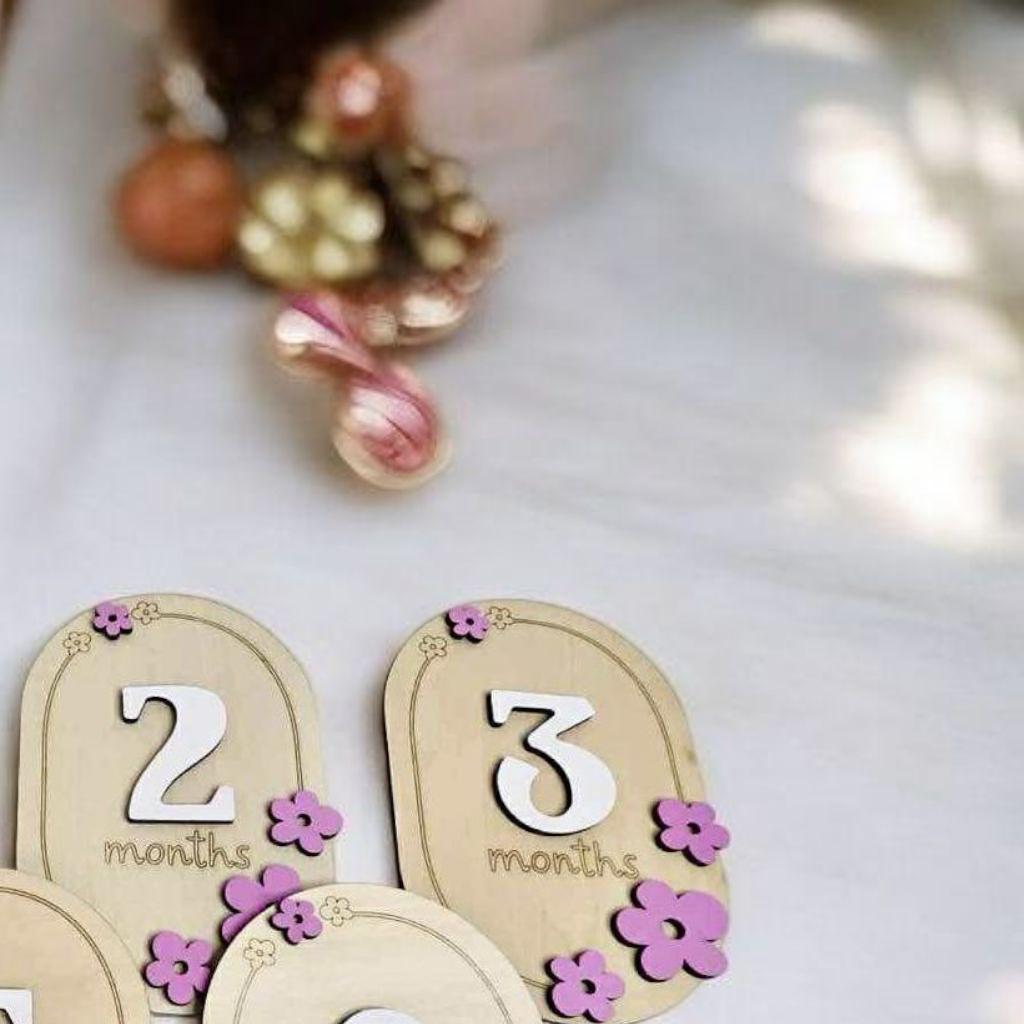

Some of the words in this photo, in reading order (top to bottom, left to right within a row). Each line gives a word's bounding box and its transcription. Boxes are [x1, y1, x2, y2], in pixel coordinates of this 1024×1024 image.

[120, 684, 236, 825] 2
[488, 689, 618, 836] 3
[104, 829, 251, 871] months
[487, 838, 639, 880] months
